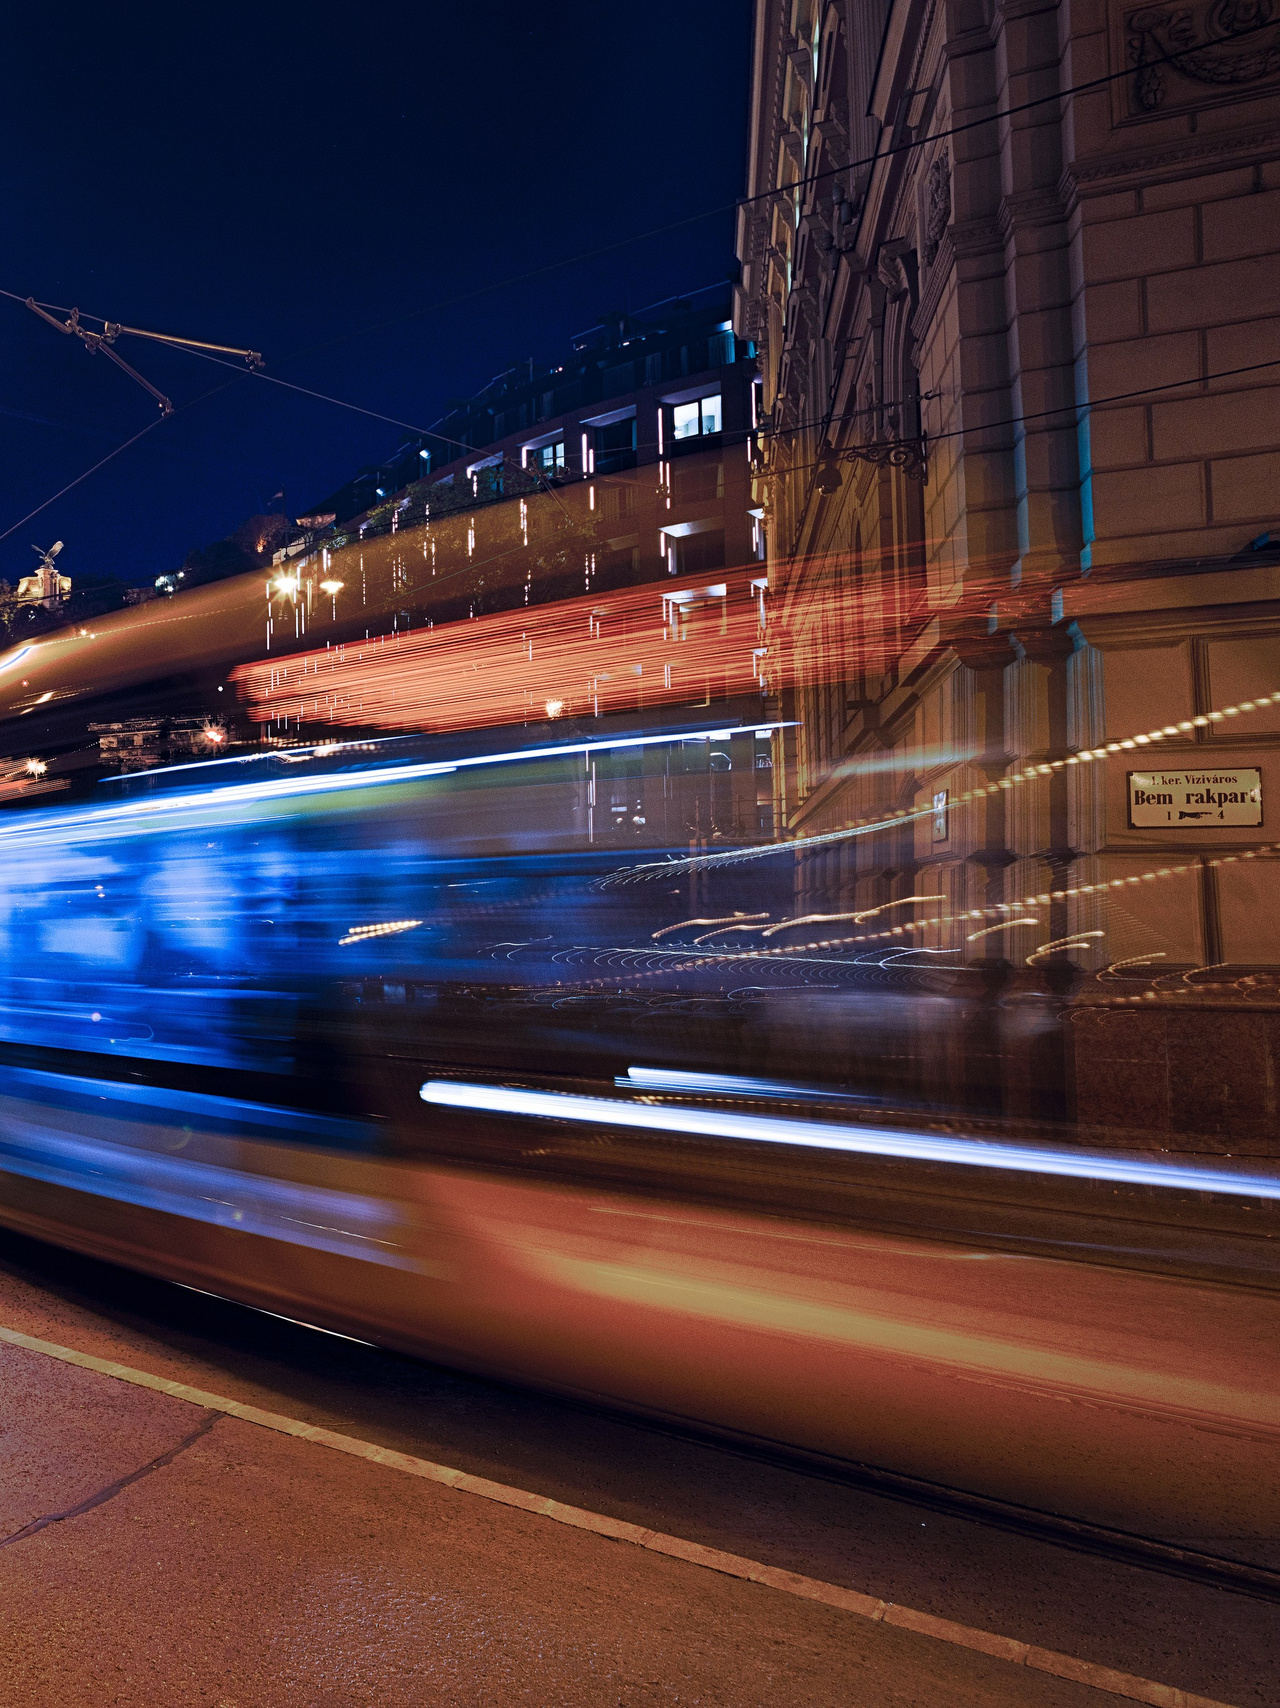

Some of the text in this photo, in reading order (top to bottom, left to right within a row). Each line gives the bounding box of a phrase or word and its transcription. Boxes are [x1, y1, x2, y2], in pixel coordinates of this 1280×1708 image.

[1161, 775, 1182, 786] ker.
[1184, 774, 1238, 785] Víziváros
[1134, 787, 1258, 808] Bem rakpart
[1217, 809, 1225, 820] 4
